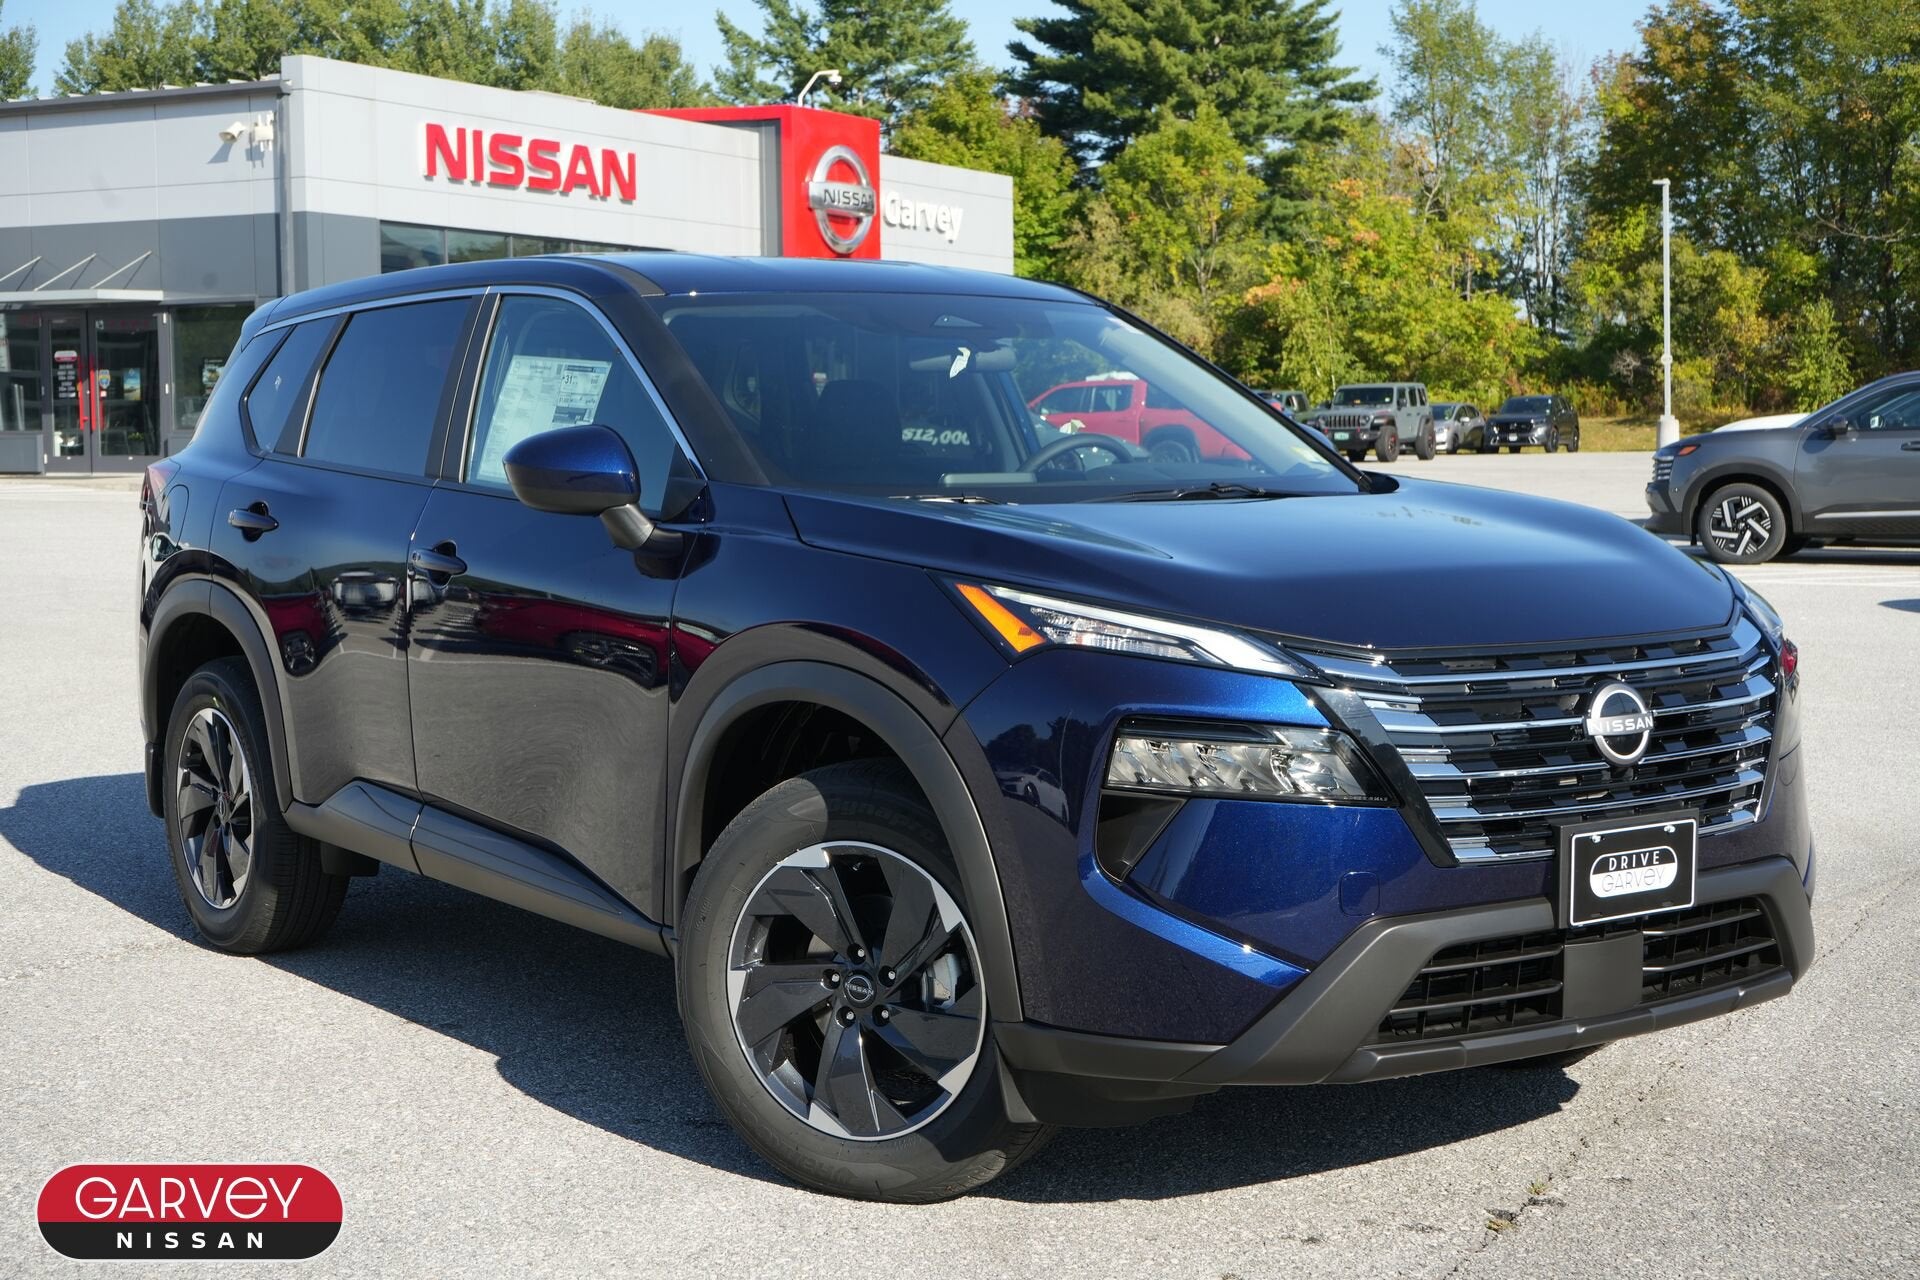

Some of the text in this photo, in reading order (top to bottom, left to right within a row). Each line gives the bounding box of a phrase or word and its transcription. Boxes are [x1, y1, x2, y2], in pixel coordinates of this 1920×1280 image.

[425, 123, 636, 200] NISSAN
[823, 188, 874, 210] NISSAN
[884, 191, 963, 241] Garvey
[1590, 715, 1653, 733] NISSAN
[1608, 850, 1660, 872] DRIVE
[844, 982, 874, 996] NISSAN
